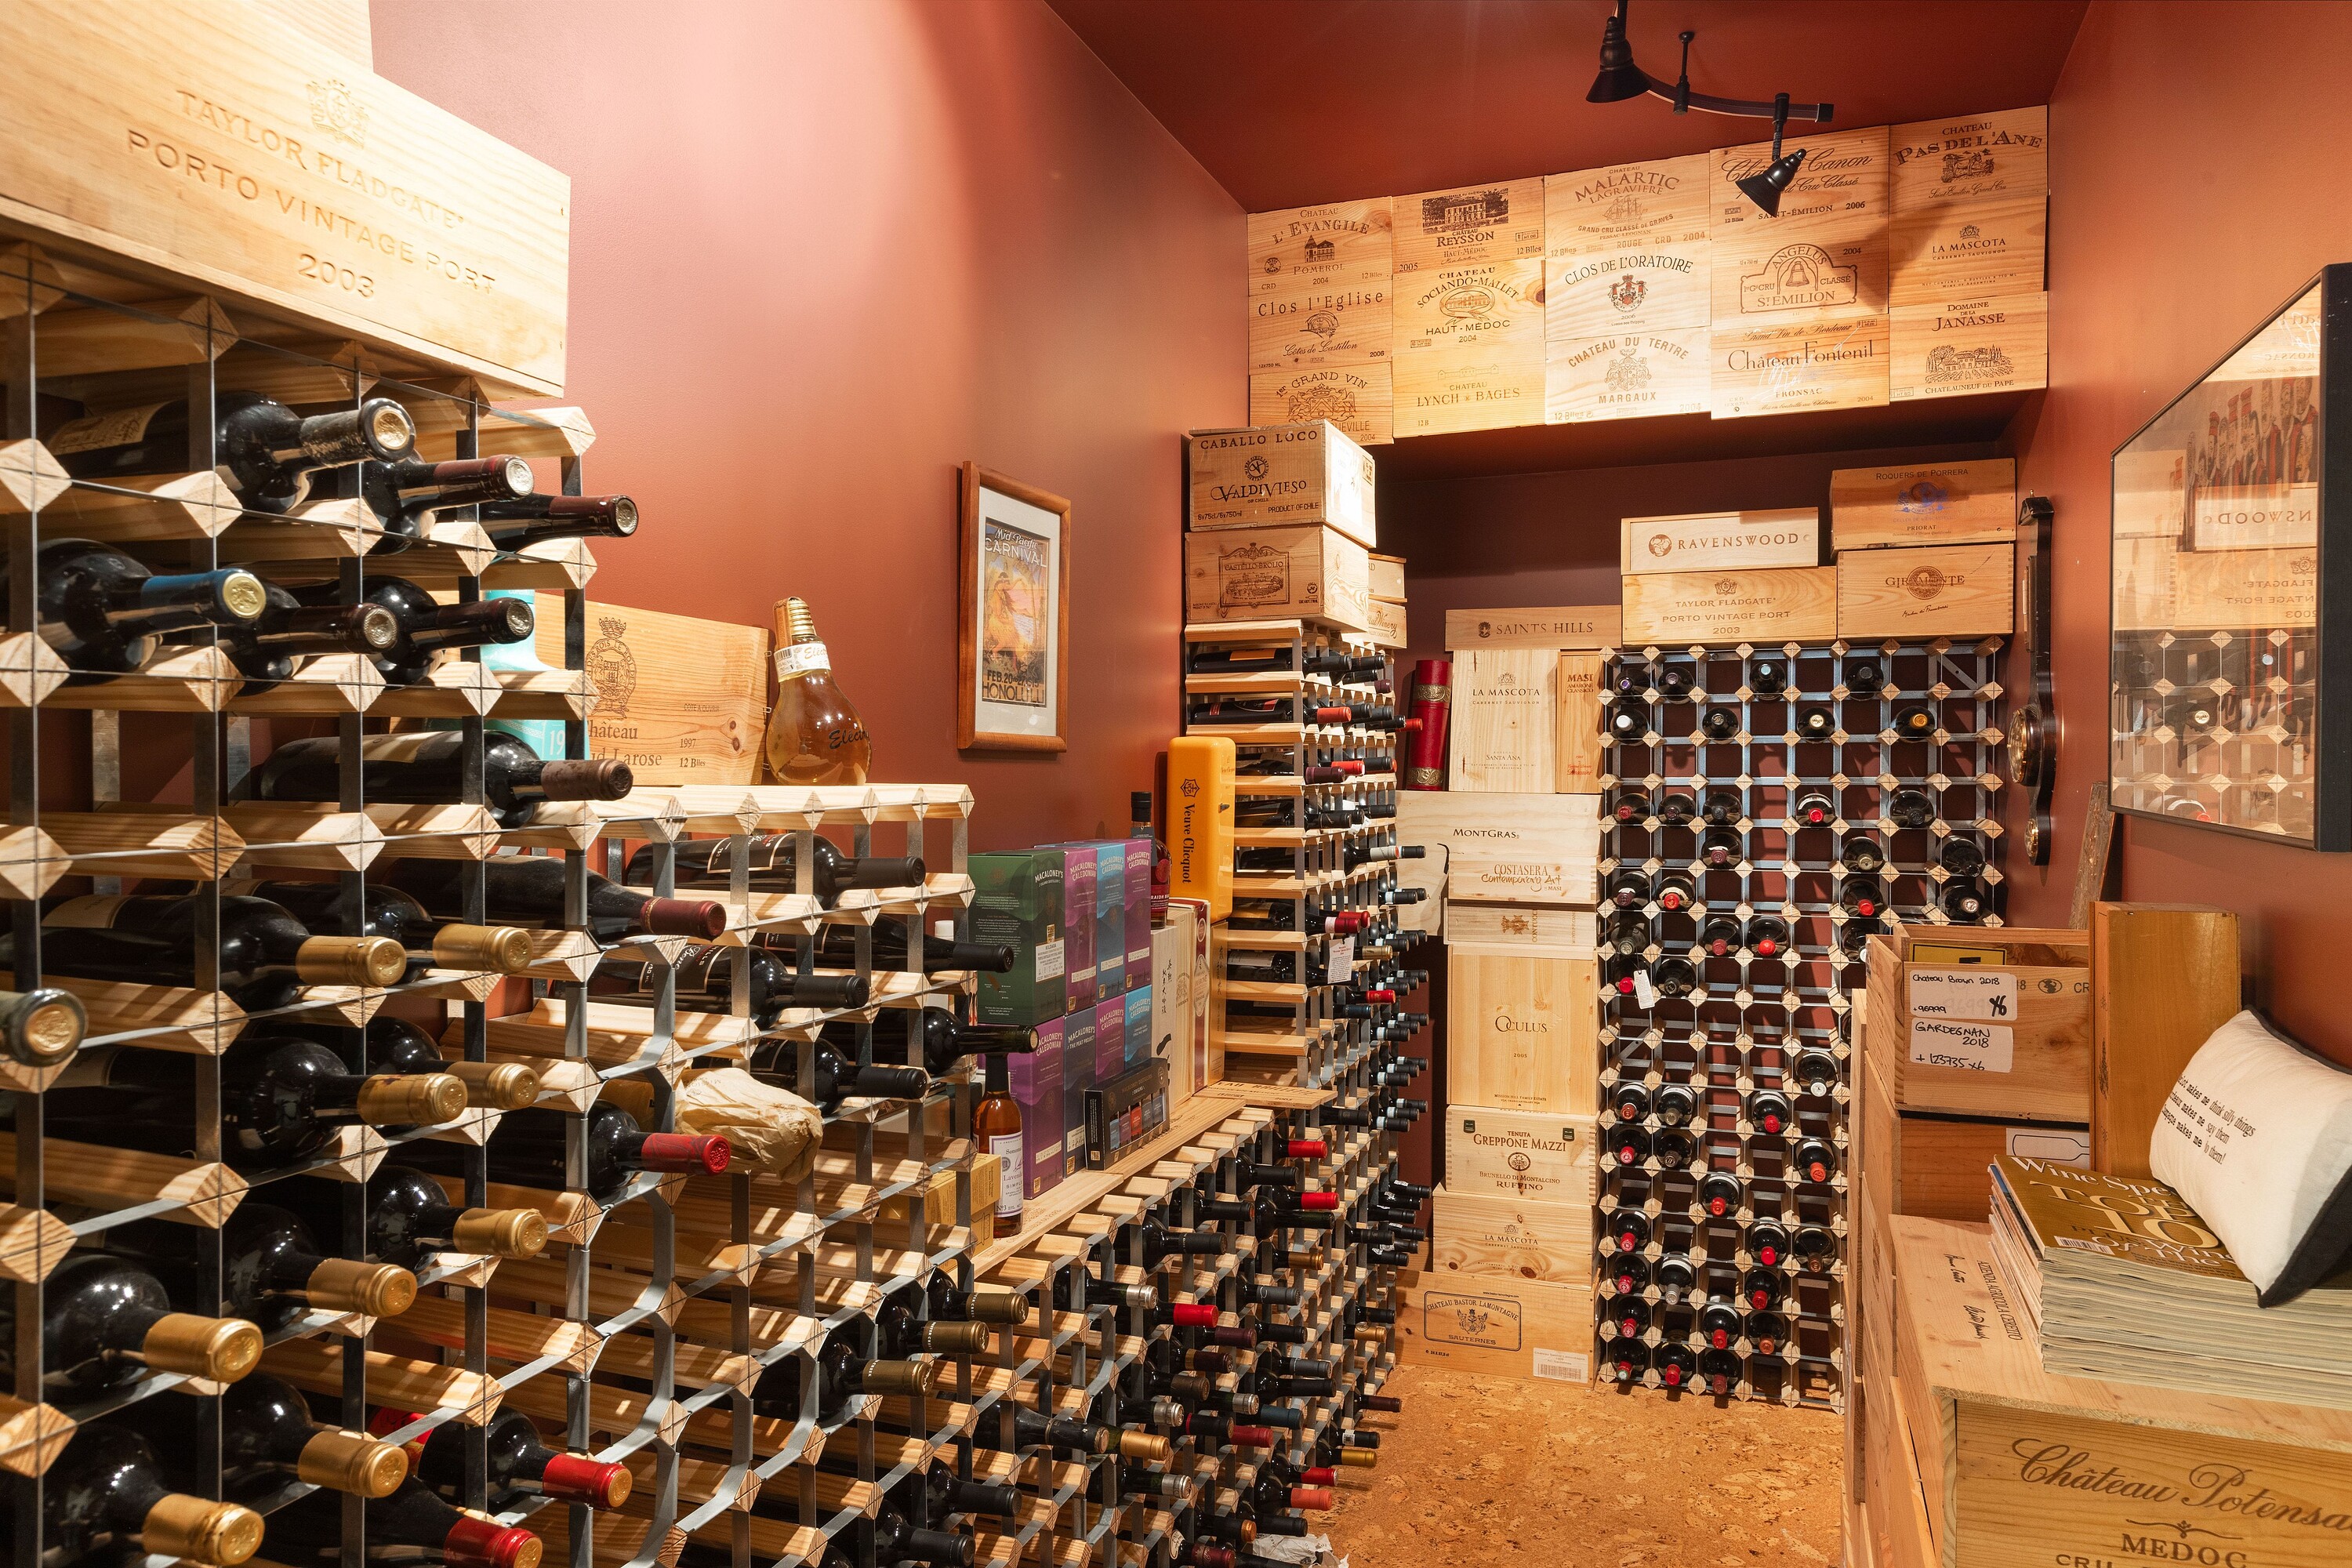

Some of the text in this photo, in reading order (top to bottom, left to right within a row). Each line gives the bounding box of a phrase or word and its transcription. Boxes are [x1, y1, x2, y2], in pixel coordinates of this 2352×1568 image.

[176, 89, 307, 170] TAYLOR
[1942, 122, 1992, 136] CHATEAU
[1803, 147, 1873, 172] Canon
[1894, 143, 1940, 166] PAS
[1609, 165, 1640, 174] CHATEAU
[1575, 172, 1680, 202] MALARTIC
[1796, 177, 1820, 192] Cru
[1821, 175, 1859, 187] Classé
[1970, 180, 2007, 195] Grand Cru
[1589, 185, 1664, 204] LAGRAVIERE
[127, 129, 496, 295] PORTO VINTAGE PORT
[1846, 201, 1865, 210] 2006
[1616, 223, 1639, 233] CLASSÉ
[1650, 214, 1674, 227] GRAVES
[1436, 231, 1495, 248] REYSSON
[1617, 231, 1706, 249] ROUGE CRD 2004
[1933, 238, 2006, 253] LA MASCOTA
[1772, 246, 1828, 269] ANGELUS
[1968, 249, 2006, 257] SAUVIGNON
[299, 253, 376, 299] 2003
[1294, 264, 1345, 274] POMEROL
[1399, 263, 1418, 273] 2005
[1439, 267, 1496, 279] CHATEAU
[1565, 255, 1693, 285] CLOS DE L'ORATOIRE
[1820, 274, 1851, 285] CLASSÉ
[1417, 278, 1519, 308] SOCIANDO-MALLET
[1773, 291, 1835, 307] EMILION
[1258, 292, 1383, 317] Clos l'Eglise
[1947, 302, 1989, 311] DOMAINE
[1932, 313, 2005, 332] JANASSE
[1568, 337, 1689, 368] CHATEAU DU TERTRE
[1729, 350, 1800, 370] Château
[1291, 372, 1368, 389] GRAND VIN
[1450, 382, 1487, 390] CHATEAU
[1926, 383, 1981, 394] CHATEAUNEUF
[1417, 388, 1520, 407] LYNCH BAGES
[1599, 392, 1657, 404] MARGAUX
[1776, 388, 1822, 398] FRONSAC
[1201, 430, 1317, 450] CABALLO LOCO
[1876, 469, 1968, 480] ROQUERS PORRERA
[1268, 505, 1294, 514] PRODUCT
[1679, 533, 1798, 550] RAVENSWOOD
[985, 538, 1047, 568] CARNIVAL
[1225, 561, 1283, 571] CASTELLO BROLIO
[1704, 612, 1755, 621] VINTAGE
[1497, 622, 1593, 635] SAINTS HILLS
[1567, 673, 1593, 682] MASI
[982, 681, 1044, 703] HONOLULU
[588, 720, 638, 739] hâteau
[680, 739, 696, 748] 1997
[679, 757, 688, 768] 12
[1182, 804, 1195, 884] Veuve Clicquot
[1100, 855, 1124, 867] MACALONEY'S
[1127, 851, 1150, 863] MACALONEY'S
[1128, 859, 1149, 869] CALEDONIAN
[1035, 869, 1064, 883] MACALONEY'S
[1070, 862, 1097, 874] MACALONEY'S
[1072, 870, 1096, 881] CALEDONIAN
[1102, 865, 1123, 874] CALEDONIAN
[1494, 864, 1548, 877] COSTASERA
[1481, 873, 1562, 892] Contemporary Art
[1912, 974, 1944, 982] Chateau
[1948, 975, 1974, 985] Brown
[1128, 997, 1151, 1013] MACALONEY'S
[1099, 1009, 1124, 1024] MACALONEY'S
[1101, 1018, 1123, 1031] CALEDONIAN
[1495, 1015, 1548, 1033] OCULUS
[1068, 1025, 1095, 1042] MACALONEY'S
[1915, 1022, 1991, 1038] GARDEGNAN
[1036, 1043, 1062, 1057] CALEDONIAN
[1962, 1036, 1989, 1048] 2018
[2187, 1084, 2256, 1137] makes think things
[2181, 1103, 2216, 1137] makes say
[2176, 1122, 2192, 1139] makes
[1474, 1134, 1566, 1152] GREPPONE MAZZI
[1479, 1171, 1560, 1185] BRUNELLO MONTALCINO
[2011, 1156, 2100, 1185] Wine
[1497, 1181, 1543, 1191] RUFFINO
[1497, 1236, 1538, 1246] MASCOTA
[1976, 1260, 1997, 1283] AZIENDA
[1987, 1283, 2010, 1312] AGRICOLA
[2000, 1314, 2023, 1341] CERETTO
[1427, 1299, 1453, 1311] CHATEAU
[1479, 1301, 1519, 1321] LAMONTAGNE
[1448, 1334, 1497, 1345] SAUTERNES
[2012, 1438, 2179, 1502] Château
[2121, 1533, 2247, 1568] MEDOC
